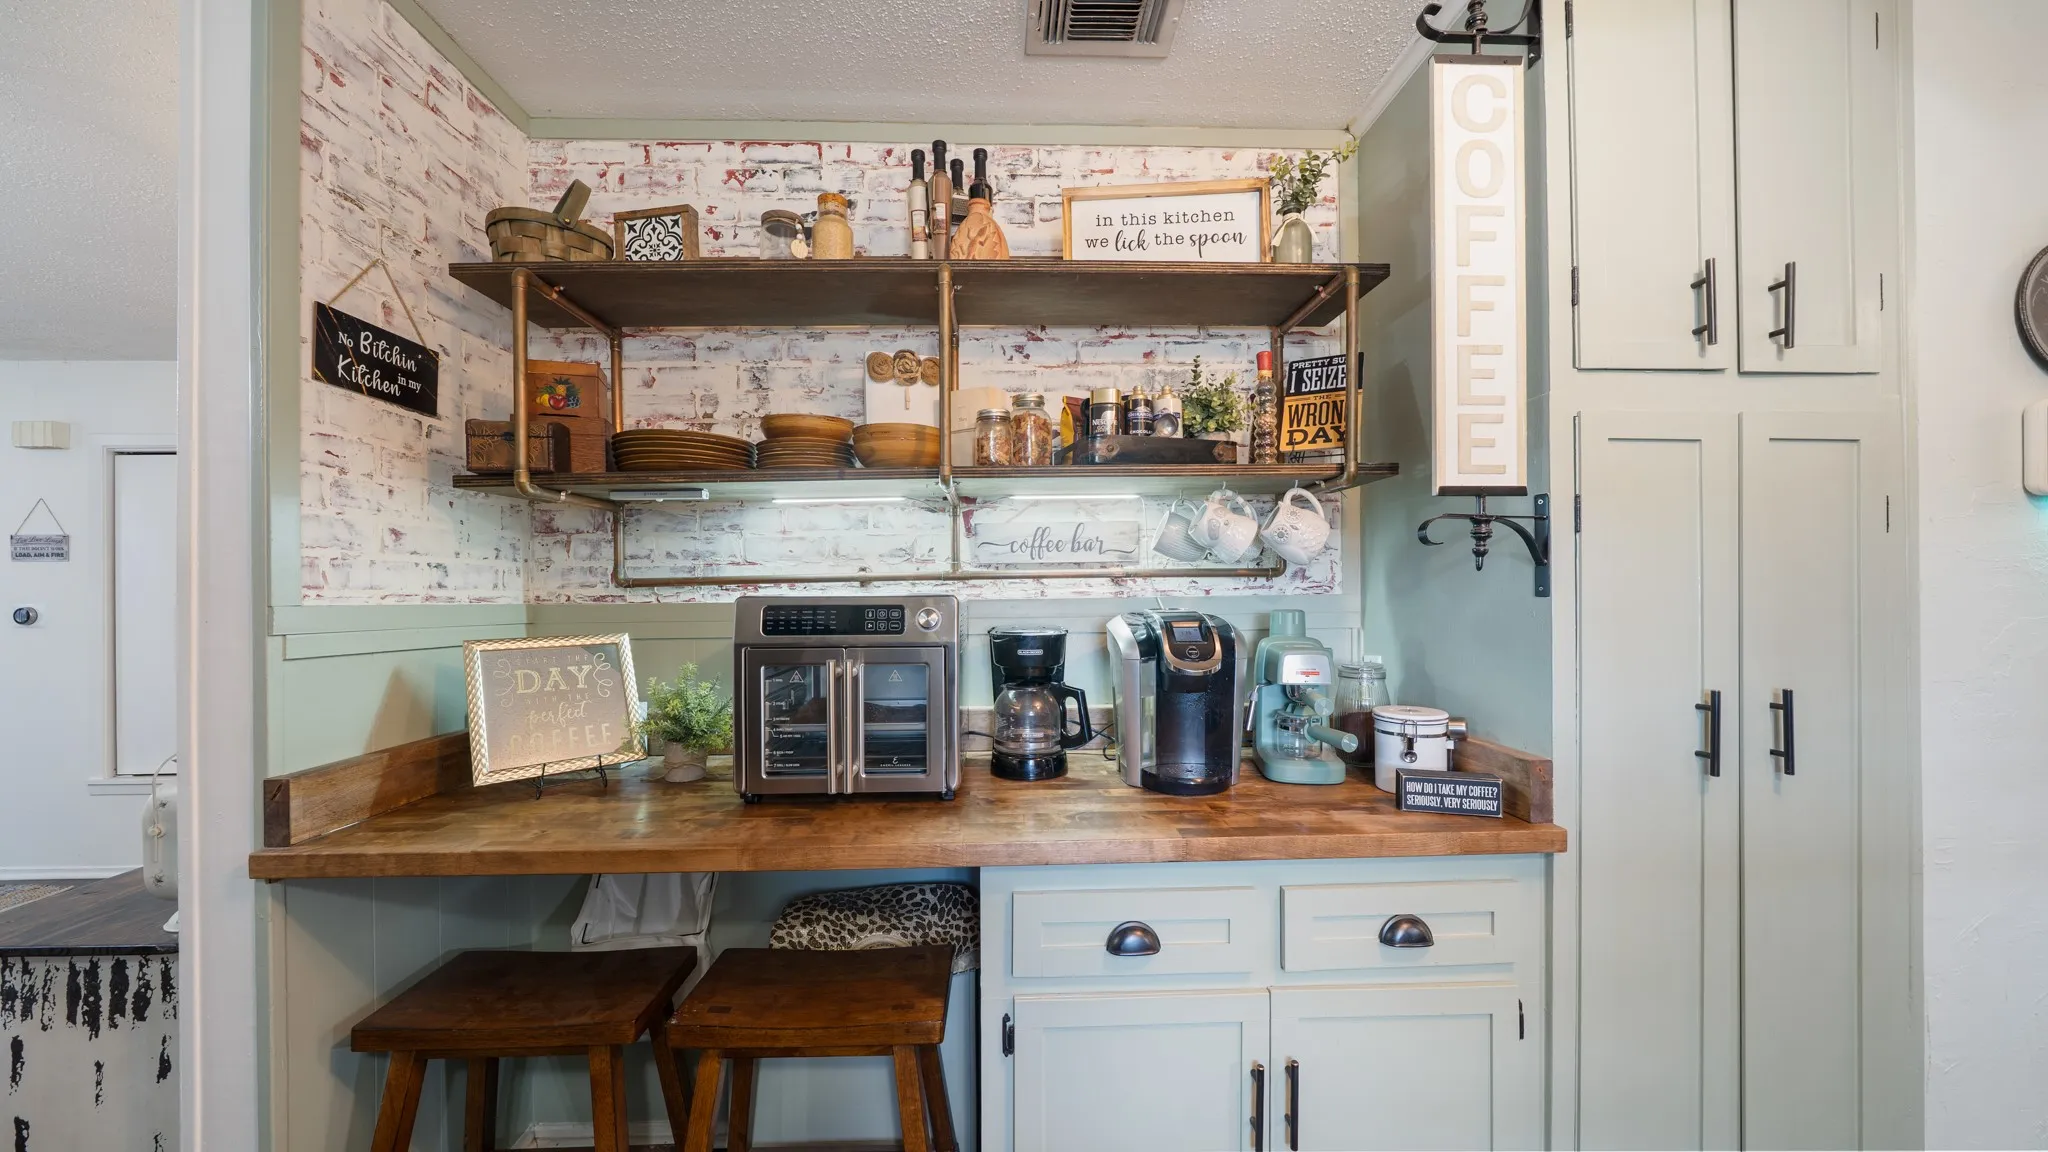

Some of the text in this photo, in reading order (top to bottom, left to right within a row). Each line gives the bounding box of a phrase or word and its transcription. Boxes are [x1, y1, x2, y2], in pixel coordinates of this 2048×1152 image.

[1095, 210, 1235, 227] in this kitchen
[1085, 229, 1248, 259] we lick the spoon
[1450, 74, 1508, 475] COFFEE
[338, 331, 354, 348] No
[337, 354, 401, 397] Kitchen
[1292, 356, 1347, 370] PRETTY SU
[397, 373, 422, 394] in my
[1289, 364, 1347, 394] I SEIZE
[1288, 400, 1346, 429] WRON
[1009, 526, 1065, 561] coffee
[514, 665, 593, 694] DAY
[526, 700, 590, 731] perfect
[509, 723, 612, 751] COFFEE
[1406, 781, 1422, 793] HOW
[1423, 782, 1432, 794] DO
[1438, 783, 1455, 796] TAKE
[1456, 784, 1467, 797] MY
[1468, 785, 1498, 798] COFFEE?
[1444, 797, 1460, 809] VERY
[1462, 798, 1498, 811] SERIOUSLY
